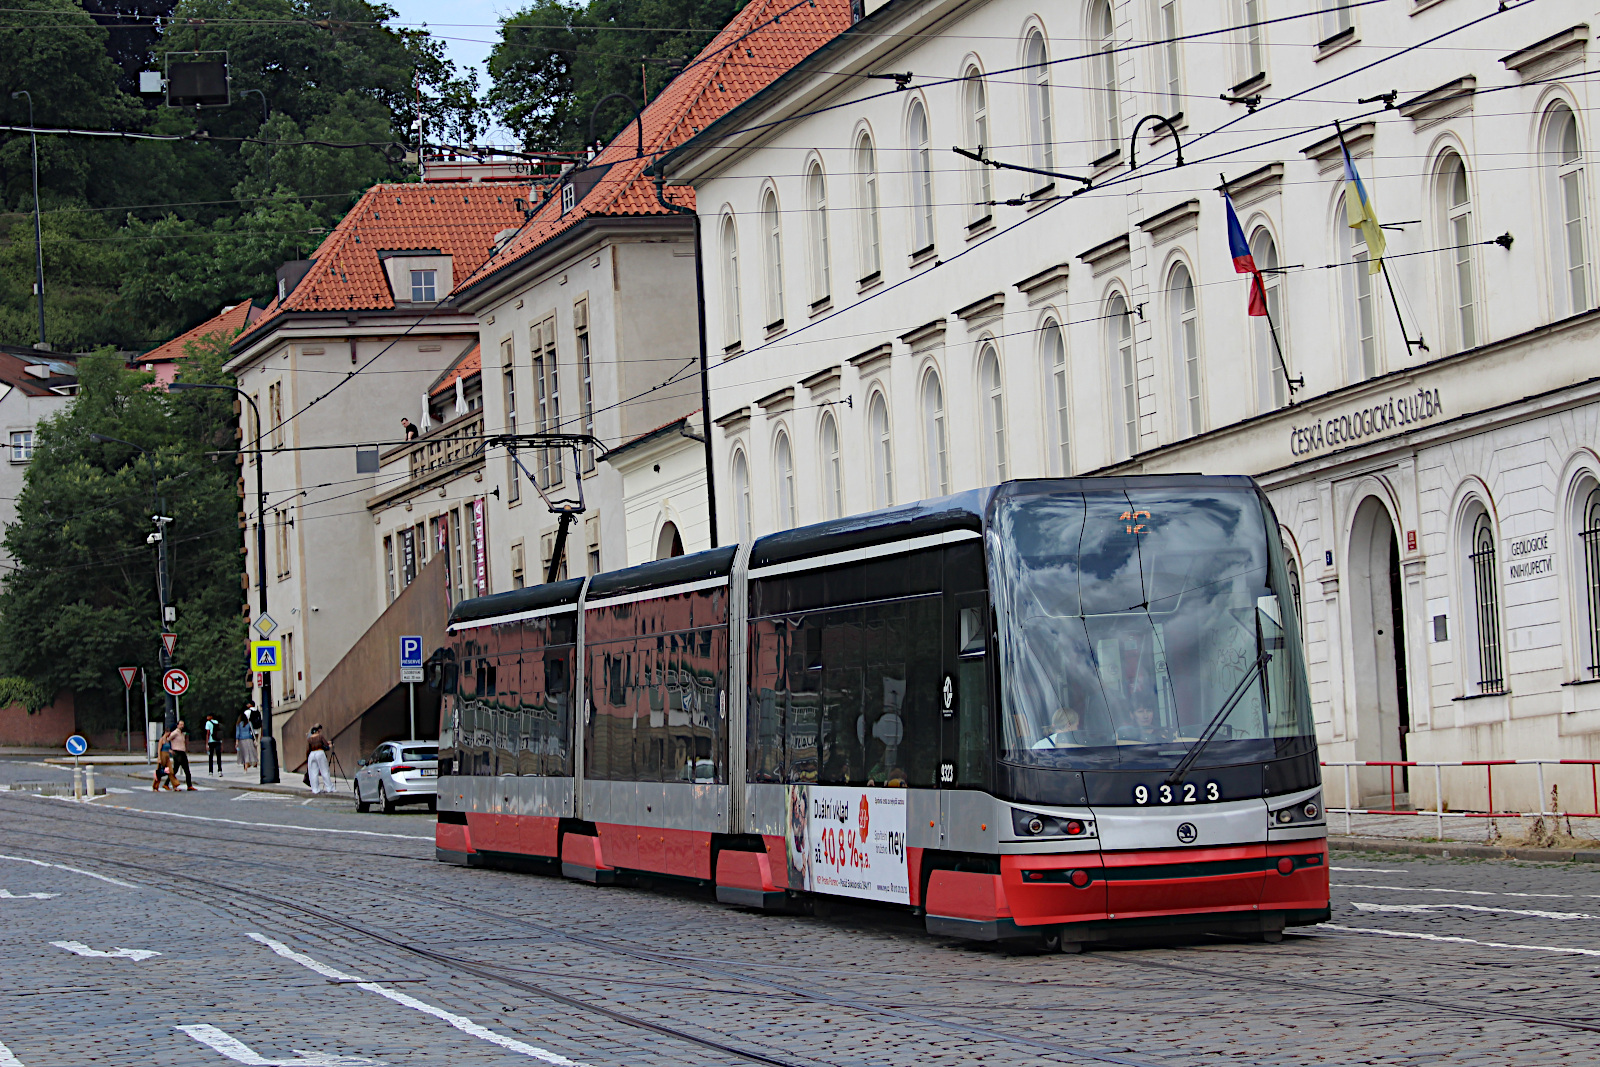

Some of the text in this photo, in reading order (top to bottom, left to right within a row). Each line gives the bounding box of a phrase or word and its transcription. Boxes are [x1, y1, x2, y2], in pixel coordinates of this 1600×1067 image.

[1290, 386, 1443, 456] ČESKÁ GEOLOGICKÁ SLUŽBA
[475, 503, 486, 589] BOHEMIA
[1511, 533, 1548, 556] GEOLOGICKÉ
[1509, 555, 1553, 579] KNIHKUPECTVÍ
[404, 639, 418, 658] P
[941, 764, 954, 782] 9323
[1135, 782, 1219, 805] 9323
[814, 797, 832, 820] Duální
[832, 800, 849, 821] vklad
[888, 830, 905, 865] ney
